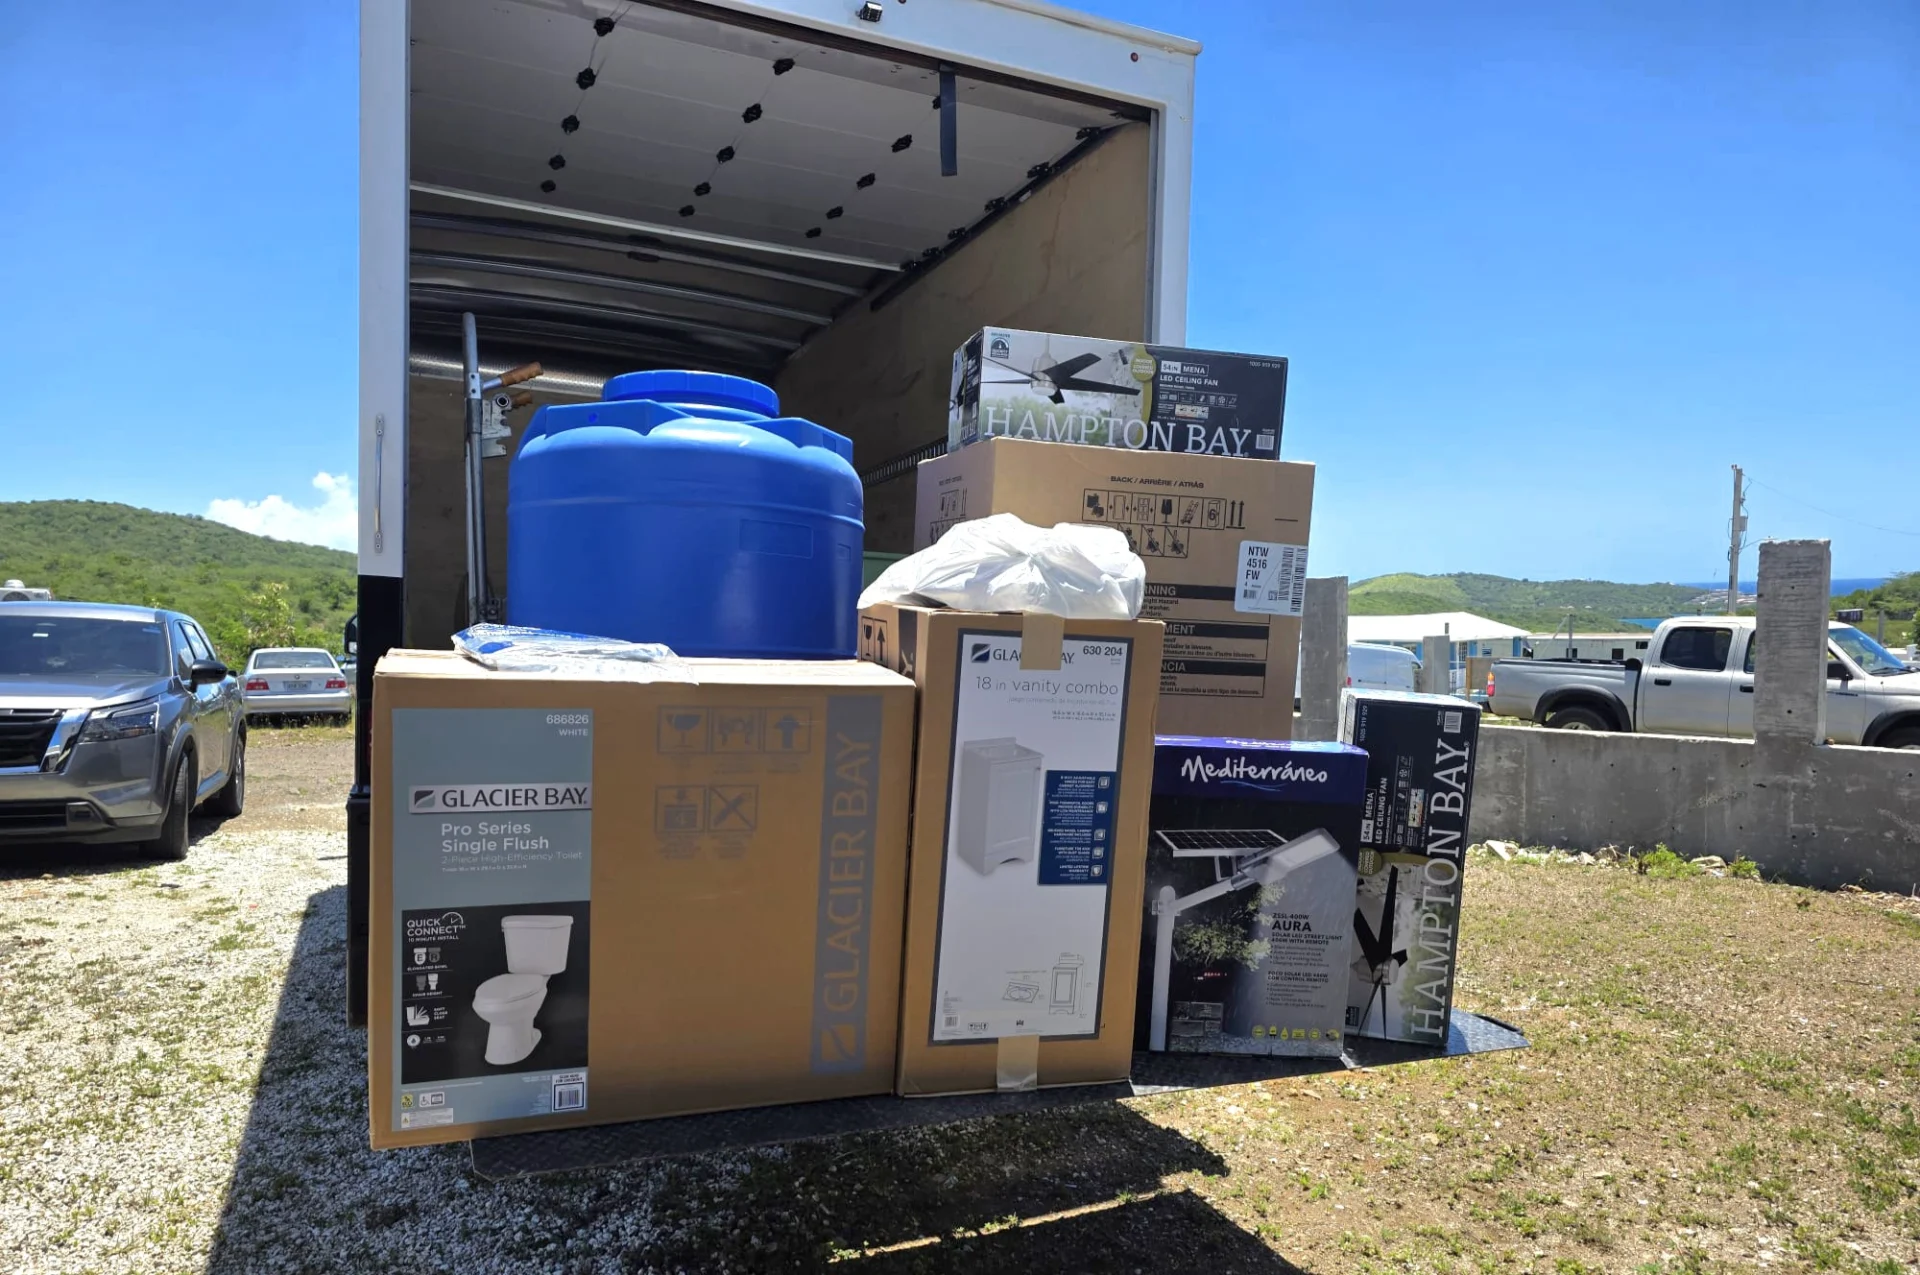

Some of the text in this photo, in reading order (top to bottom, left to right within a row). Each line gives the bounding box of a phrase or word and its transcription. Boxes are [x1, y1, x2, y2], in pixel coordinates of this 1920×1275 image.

[1183, 365, 1206, 375] MENA
[1160, 374, 1173, 383] LED
[1175, 375, 1202, 385] CEILING
[1203, 378, 1218, 387] FAN
[984, 405, 1177, 451] HAMPTON
[1110, 475, 1133, 484] BACK
[1178, 480, 1205, 489] ATRÁS
[1248, 546, 1269, 557] NTW
[1246, 558, 1268, 569] 4516
[1245, 569, 1260, 580] FW
[1165, 624, 1195, 635] MENT
[1082, 645, 1123, 656] 630 204
[976, 676, 1119, 696] 18 in vanity combo
[546, 714, 589, 725] 686826
[558, 728, 589, 737] WHITE
[1181, 755, 1328, 783] Mediterráneo
[442, 788, 539, 808] GLACIER
[1365, 792, 1374, 818] MENA
[1375, 777, 1388, 844] LED CEILING FAN
[441, 821, 532, 836] Pro Series
[441, 836, 549, 855] Single Flush
[480, 852, 553, 865] High-Efficiency
[556, 851, 582, 861] Toilet
[824, 730, 872, 1012] GLACIER BAY
[407, 918, 441, 928] QUICK
[1272, 920, 1312, 932] AURA
[1411, 826, 1462, 1038] HAMPTON
